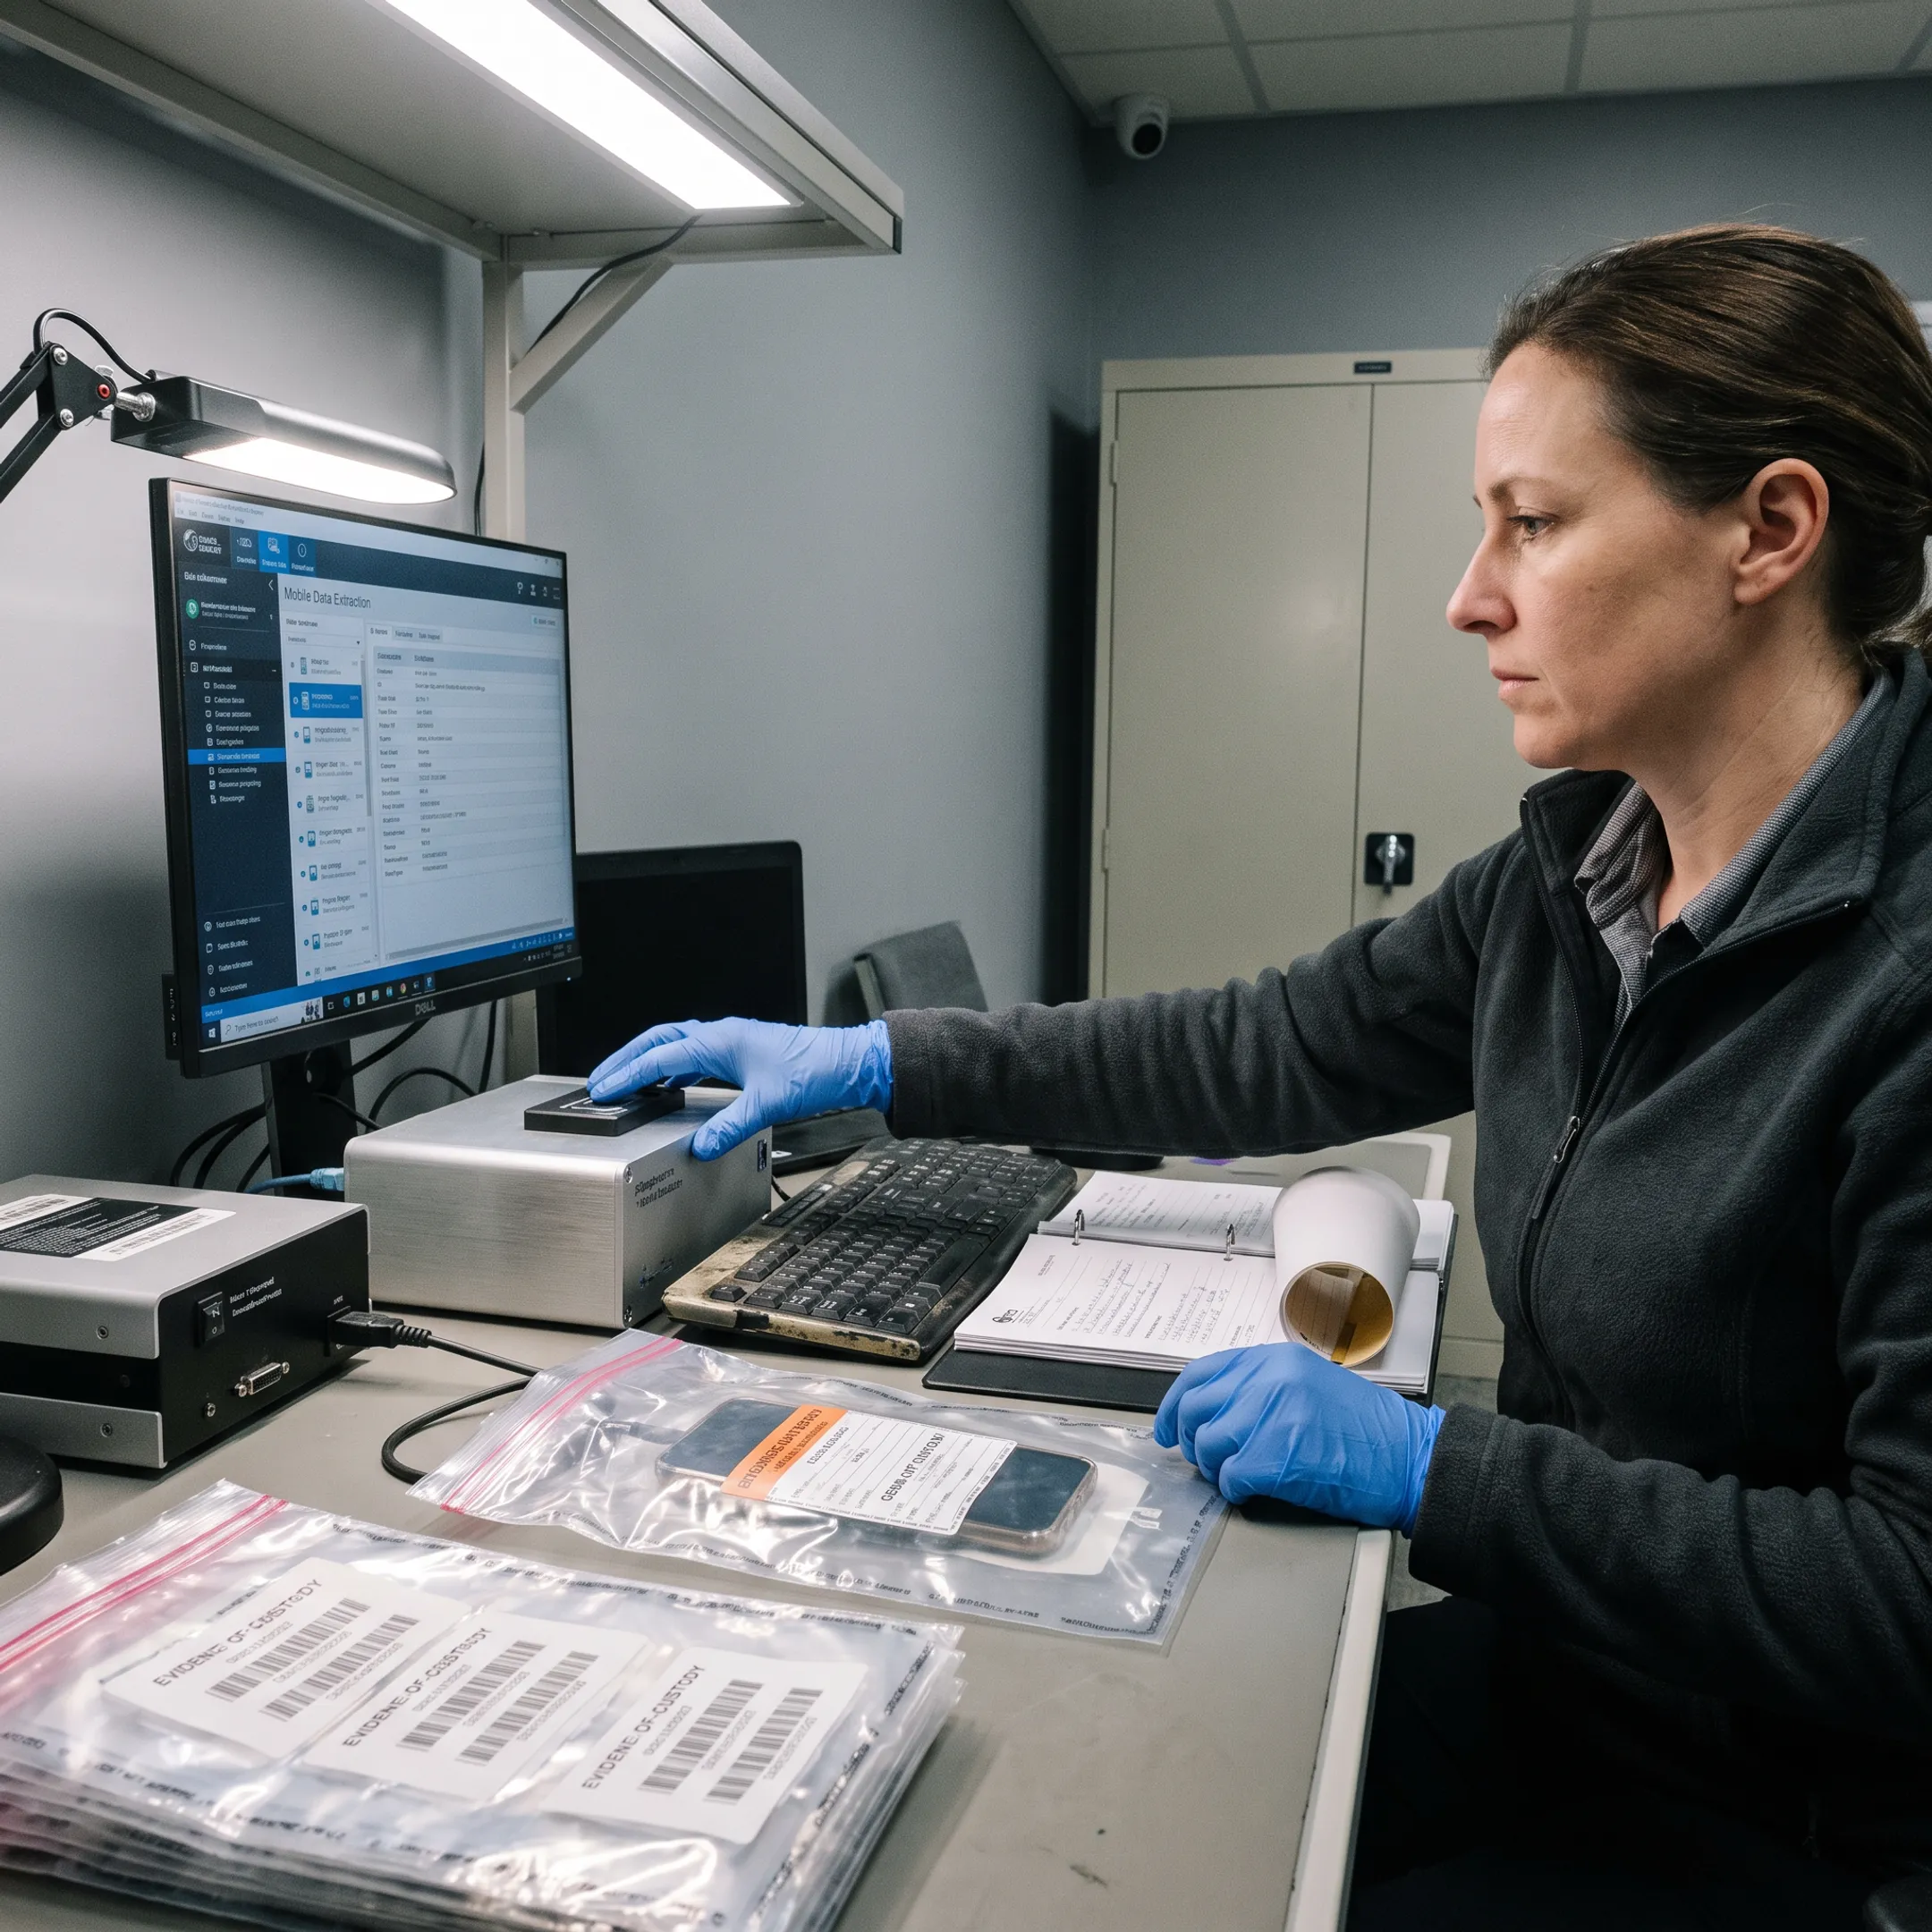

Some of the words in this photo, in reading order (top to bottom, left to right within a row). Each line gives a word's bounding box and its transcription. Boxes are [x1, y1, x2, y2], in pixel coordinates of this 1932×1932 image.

[284, 587, 311, 602] Mobile
[313, 590, 332, 605] Data
[334, 593, 371, 608] Extraction
[414, 999, 436, 1016] DELL
